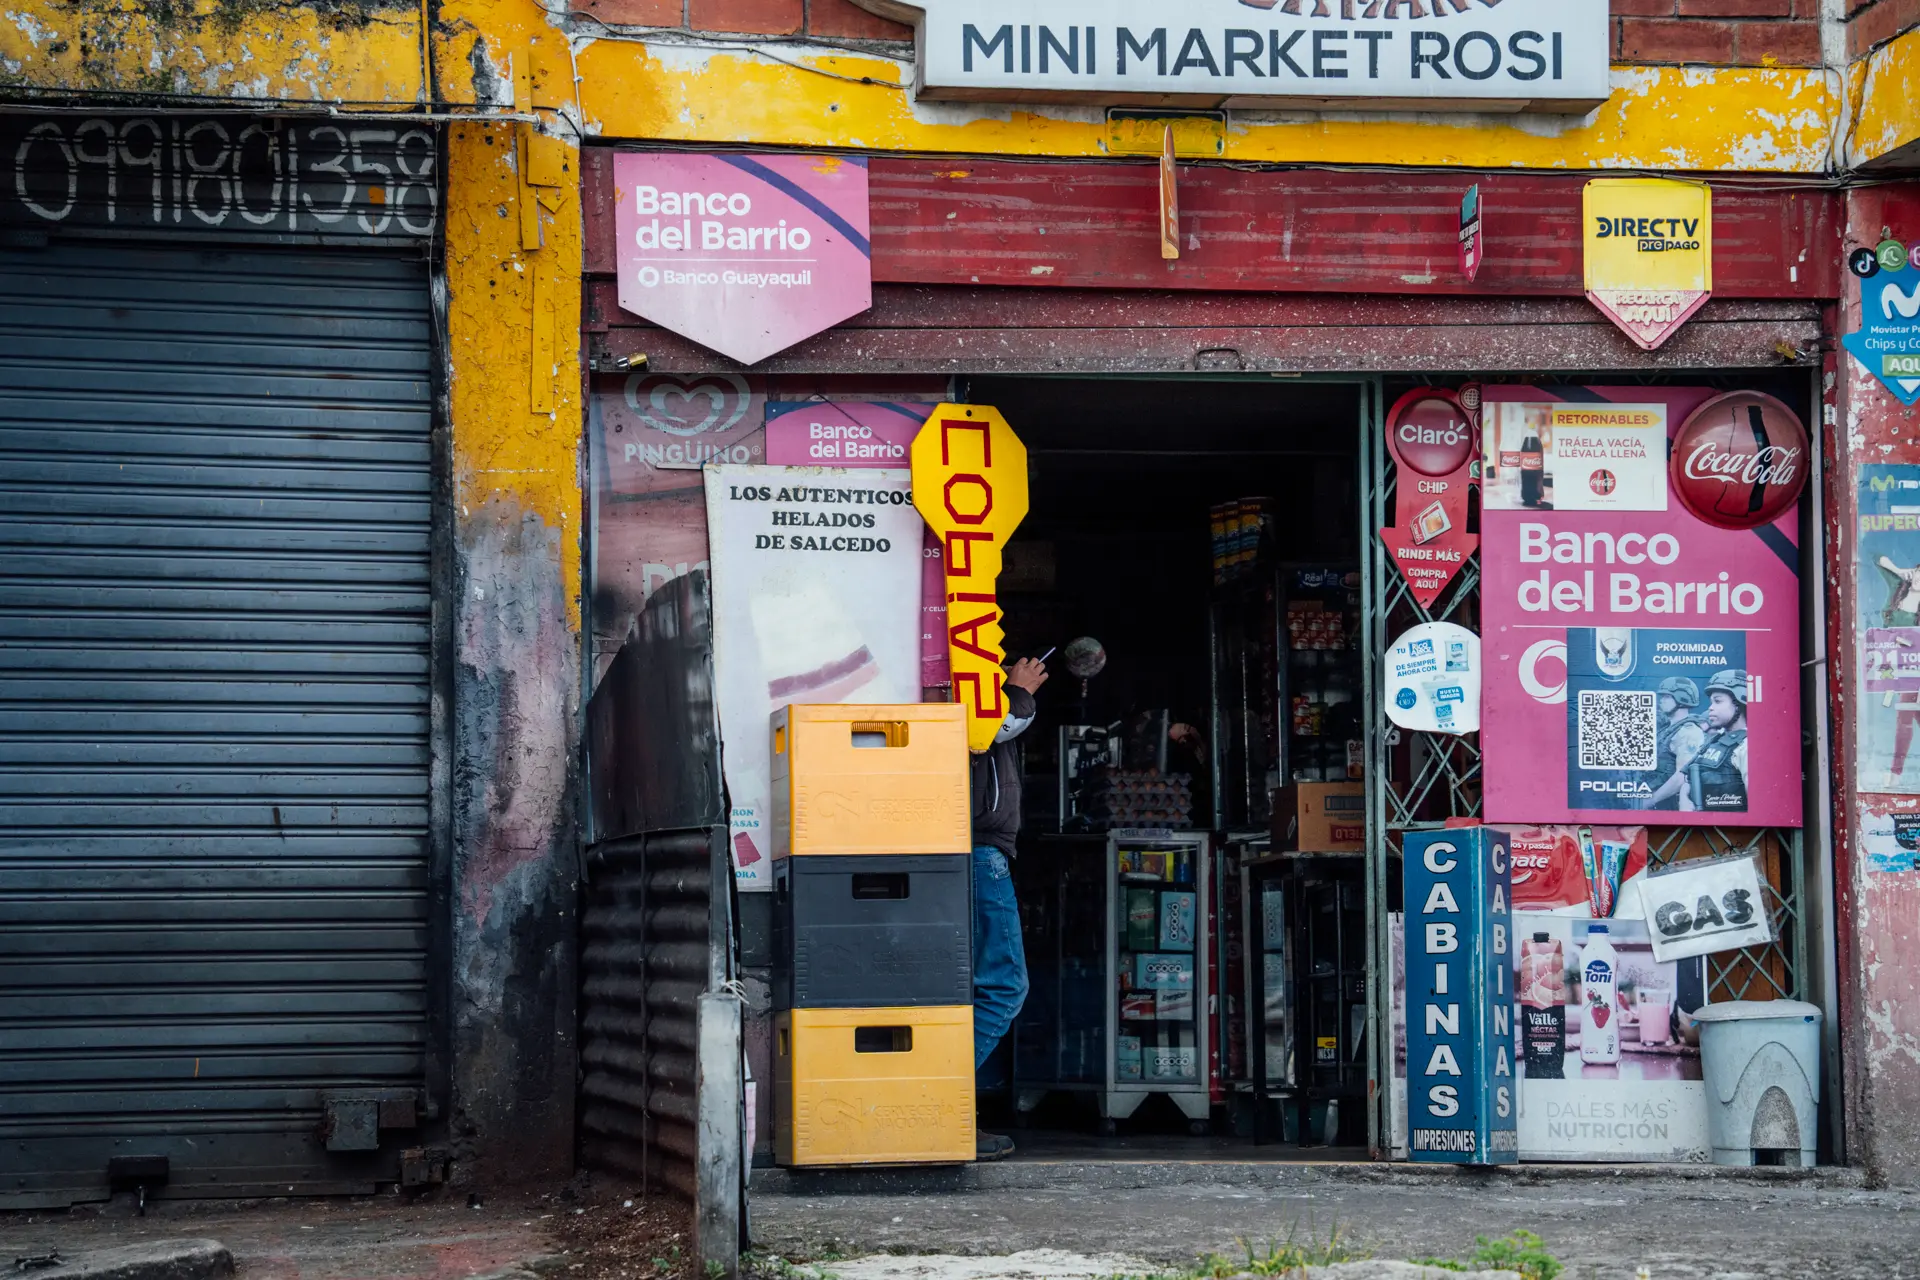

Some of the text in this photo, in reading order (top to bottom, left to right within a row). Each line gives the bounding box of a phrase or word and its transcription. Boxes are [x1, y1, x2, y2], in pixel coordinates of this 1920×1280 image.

[963, 23, 1563, 81] MINI MARKET ROSI
[636, 185, 751, 216] Banco
[635, 219, 811, 250] del Barrio
[1596, 217, 1699, 238] DIRECTV
[663, 269, 811, 288] Banco Guayaquil
[1871, 325, 1910, 334] Movistar
[1865, 338, 1896, 351] Chips
[1899, 340, 1906, 351] y
[1557, 414, 1649, 425] RETORNABLES
[810, 422, 873, 440] Banco
[1400, 420, 1460, 446] Claro
[809, 441, 904, 458] del Barrio
[1558, 436, 1645, 449] TRÁELA VACÍA,
[624, 440, 750, 464] PINGÜINO
[1558, 448, 1646, 459] LLÉVALA LLENA
[730, 485, 771, 502] LOS
[1417, 481, 1448, 494] CHIP
[772, 510, 875, 529] HELADOS
[755, 534, 891, 553] DE SALCEDO
[1519, 522, 1680, 565] Banco
[1398, 548, 1461, 562] RINDE MÁS
[1407, 568, 1448, 579] COMPRA
[1415, 578, 1438, 589] AQUÍ
[1517, 569, 1764, 616] del Barrio
[1656, 642, 1724, 654] PROXIMIDAD
[1407, 658, 1436, 669] SIEMPRE
[1652, 655, 1727, 666] COMUNITARIA
[1397, 665, 1437, 677] AHORA CON
[730, 820, 759, 828] ASAS
[1529, 843, 1554, 851] pastas
[1602, 885, 1611, 915] Colgate
[1655, 889, 1755, 937] GAS
[1422, 842, 1463, 1117] CABINAS
[1491, 843, 1511, 1118] CABINAS
[1585, 971, 1612, 983] Toni
[1528, 1013, 1558, 1025] Valle
[1546, 1098, 1669, 1119] DALES MÁS
[1547, 1119, 1669, 1139] NUTRICIÓN
[1413, 1129, 1475, 1152] IMPRESIONES
